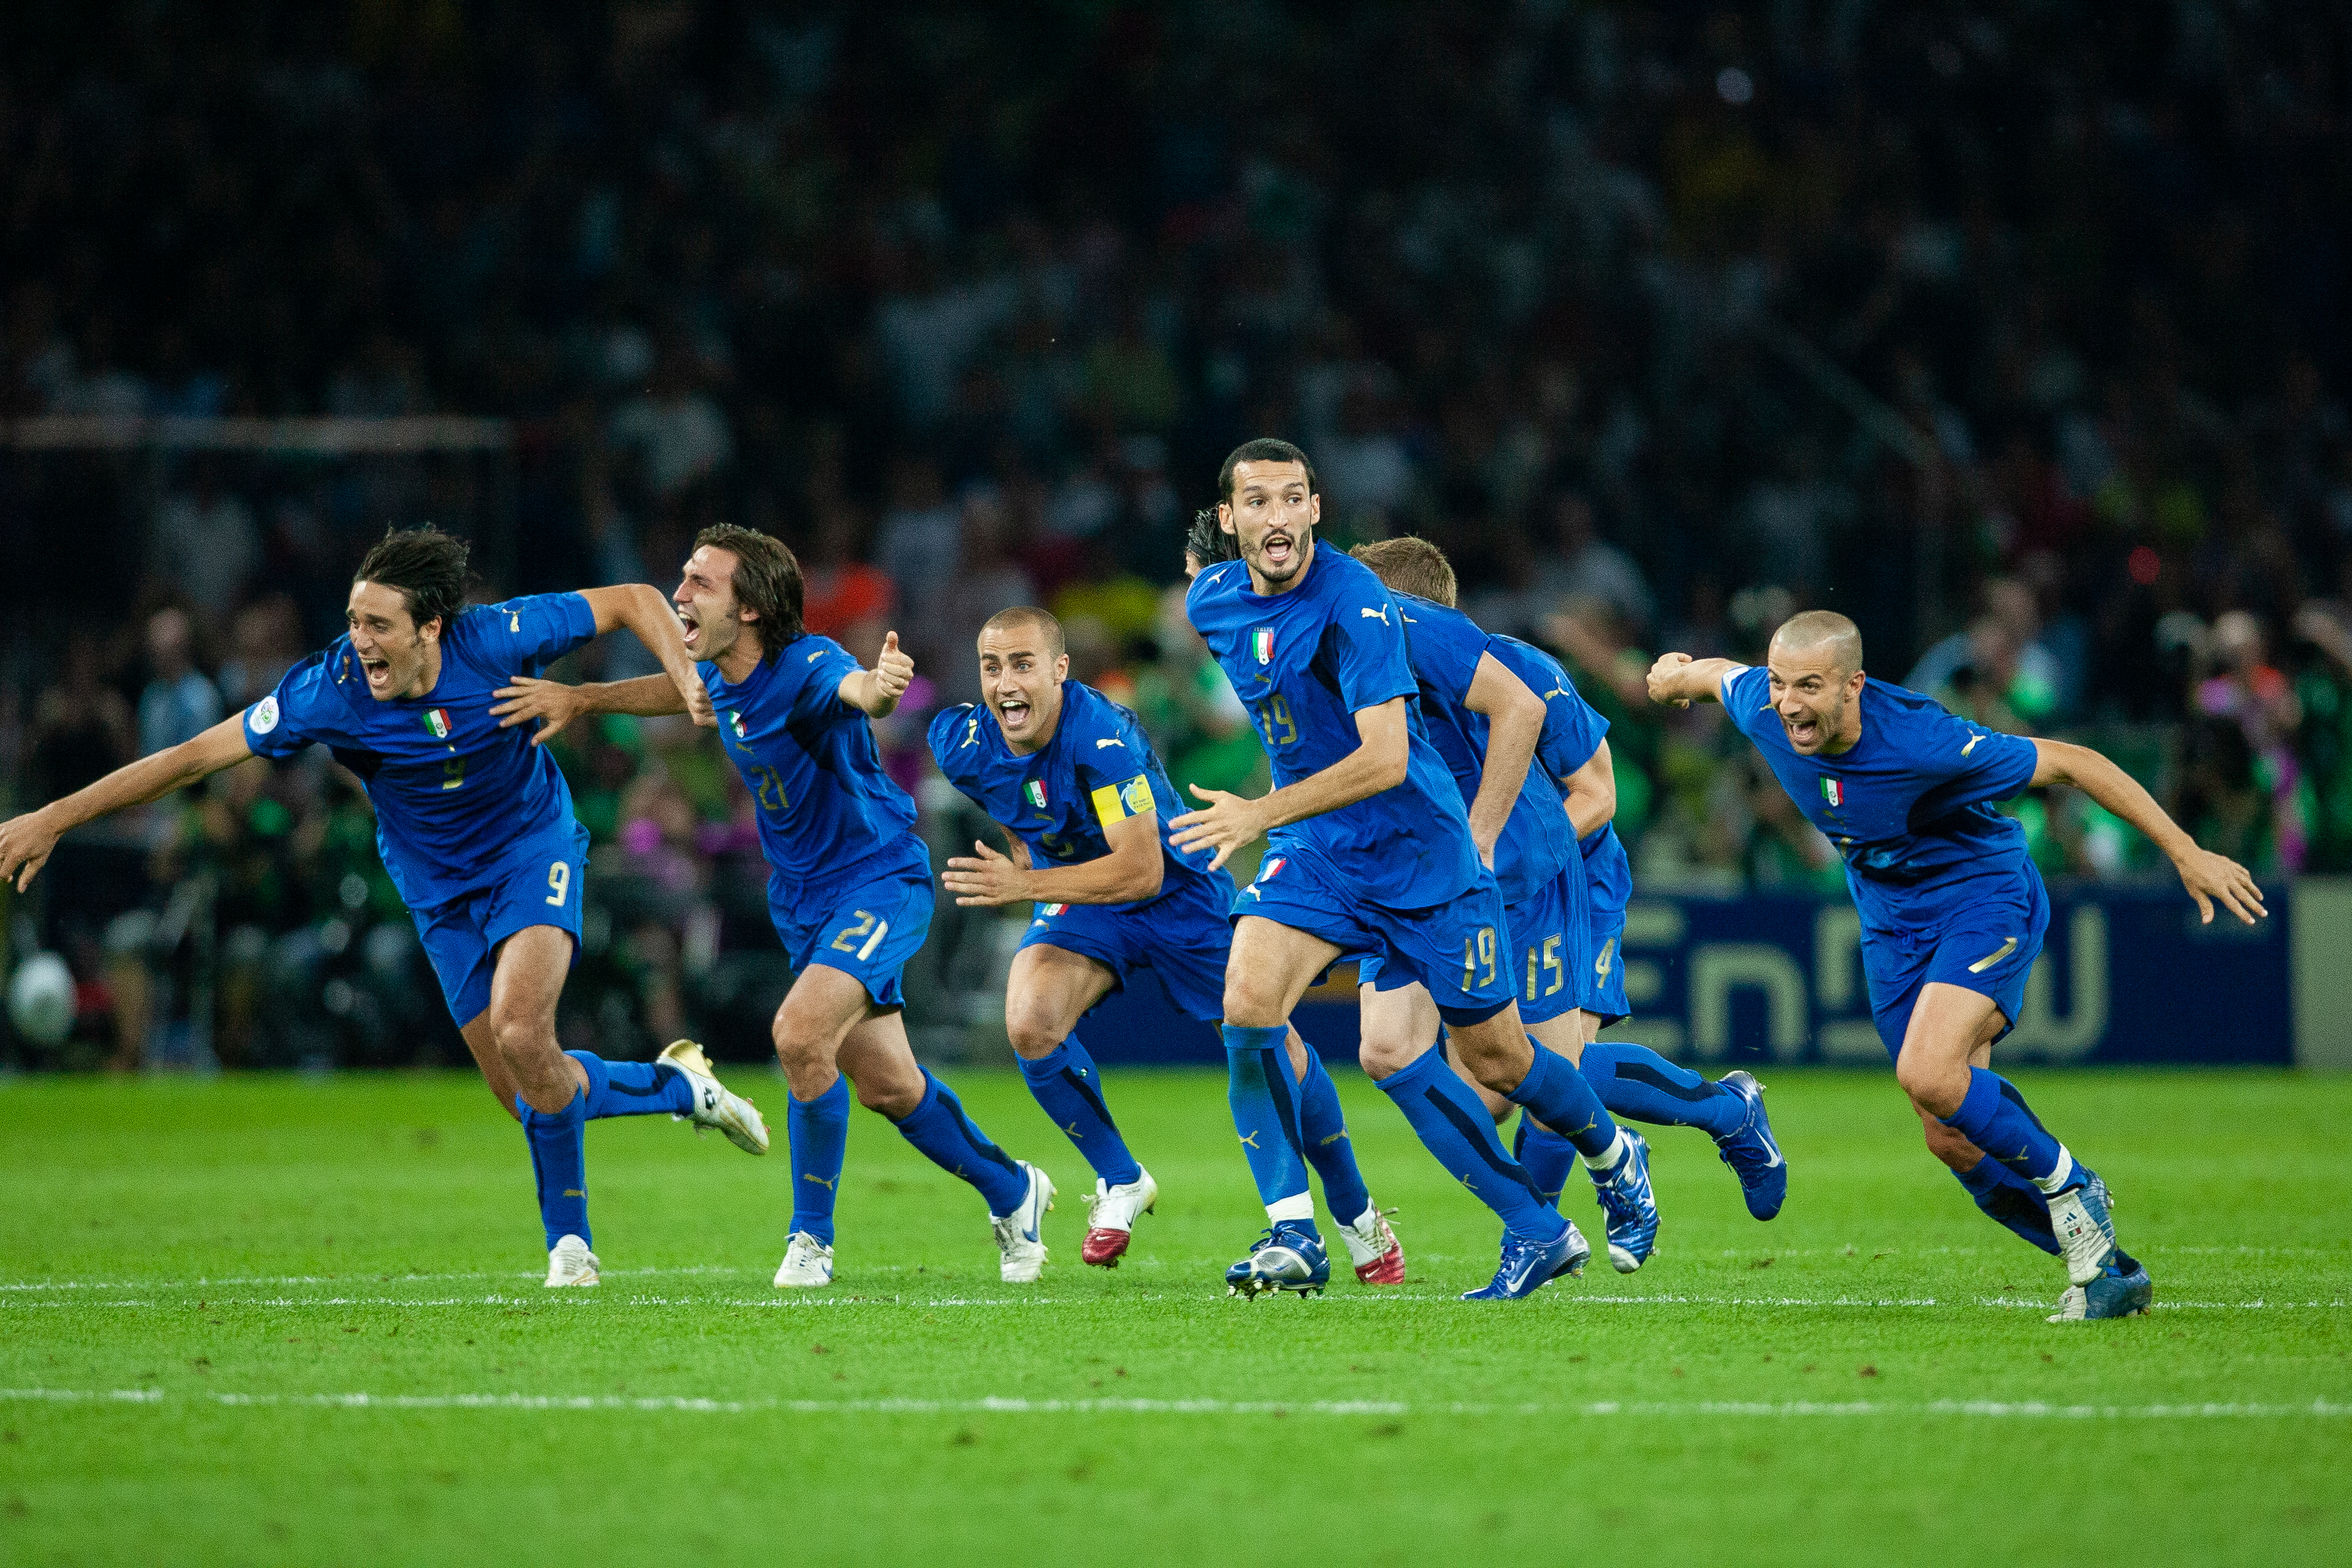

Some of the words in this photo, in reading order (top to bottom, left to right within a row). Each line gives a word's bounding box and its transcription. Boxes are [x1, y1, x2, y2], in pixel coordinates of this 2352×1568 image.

[1257, 693, 1297, 744] 19
[442, 754, 468, 790] 9
[751, 765, 789, 810] 21
[546, 860, 571, 908] 9
[831, 908, 889, 961] 21
[1461, 926, 1497, 992] 19
[1968, 936, 2018, 974] 7
[1526, 932, 1564, 1001] 15
[1595, 937, 1616, 989] 4
